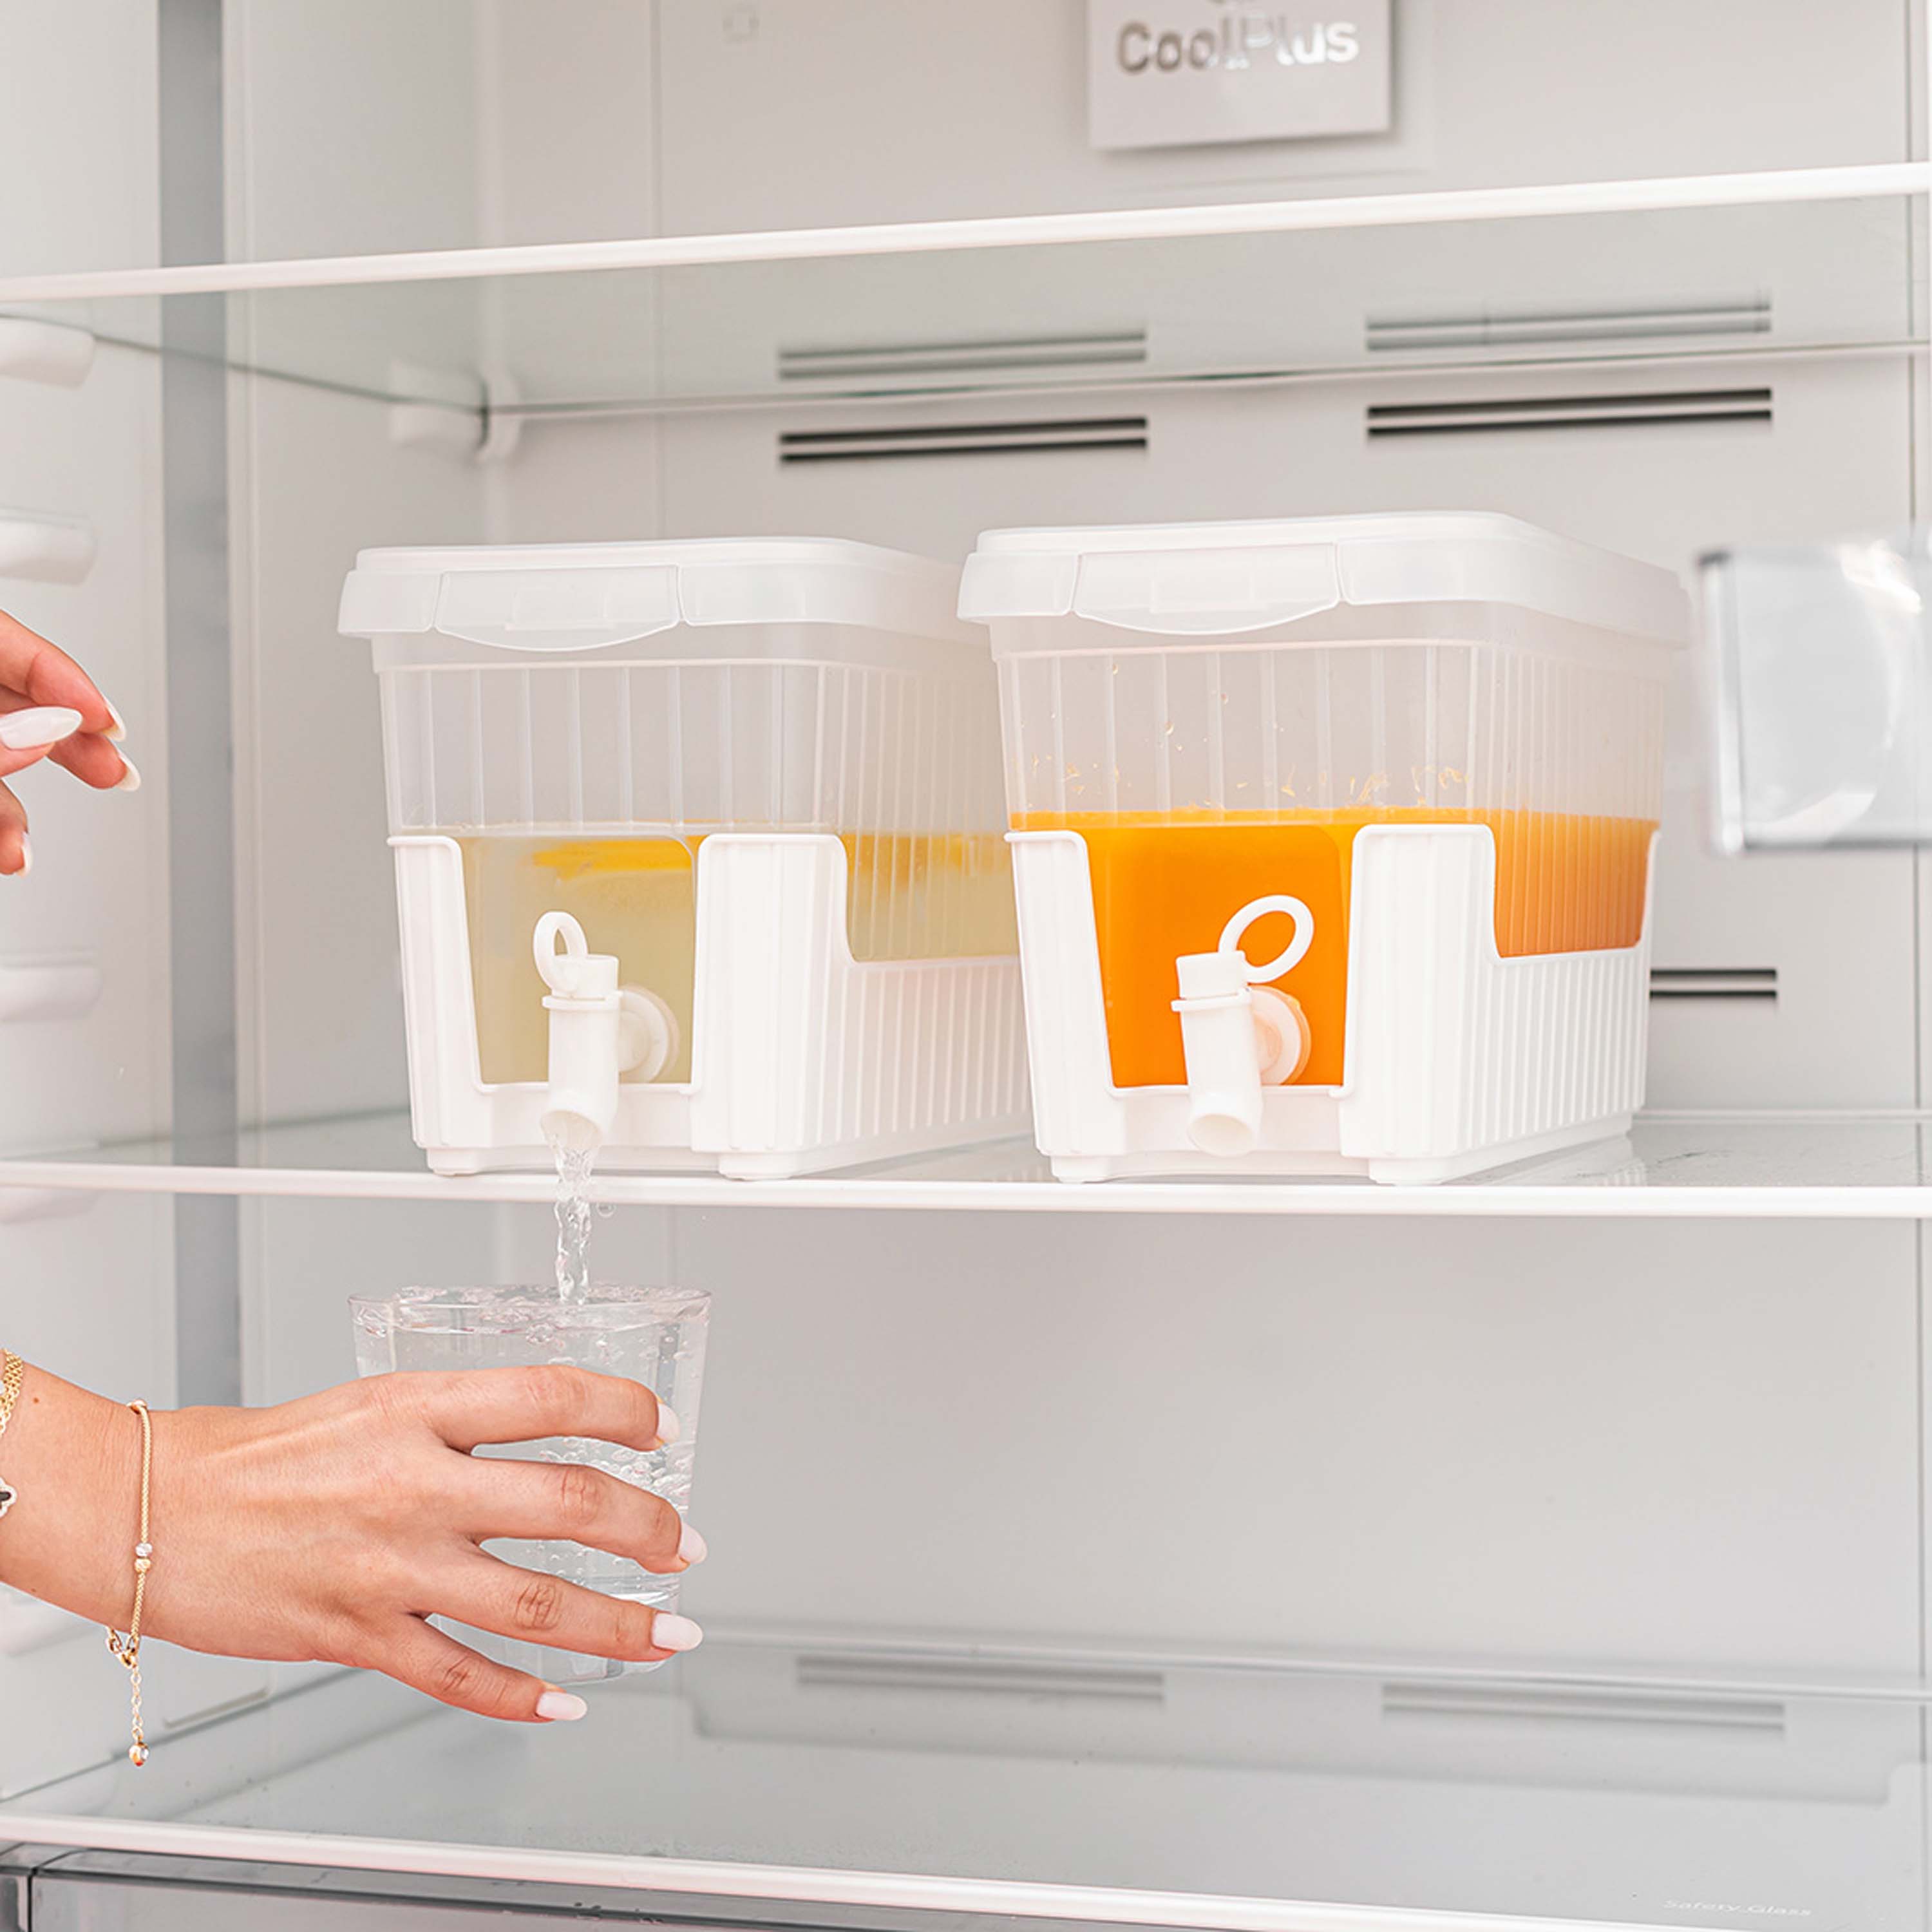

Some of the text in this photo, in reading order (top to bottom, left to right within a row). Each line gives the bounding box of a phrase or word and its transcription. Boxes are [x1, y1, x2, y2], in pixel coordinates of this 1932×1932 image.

[1117, 13, 1360, 74] CoolPlus
[1663, 1900, 1812, 1917] Safety Glass
